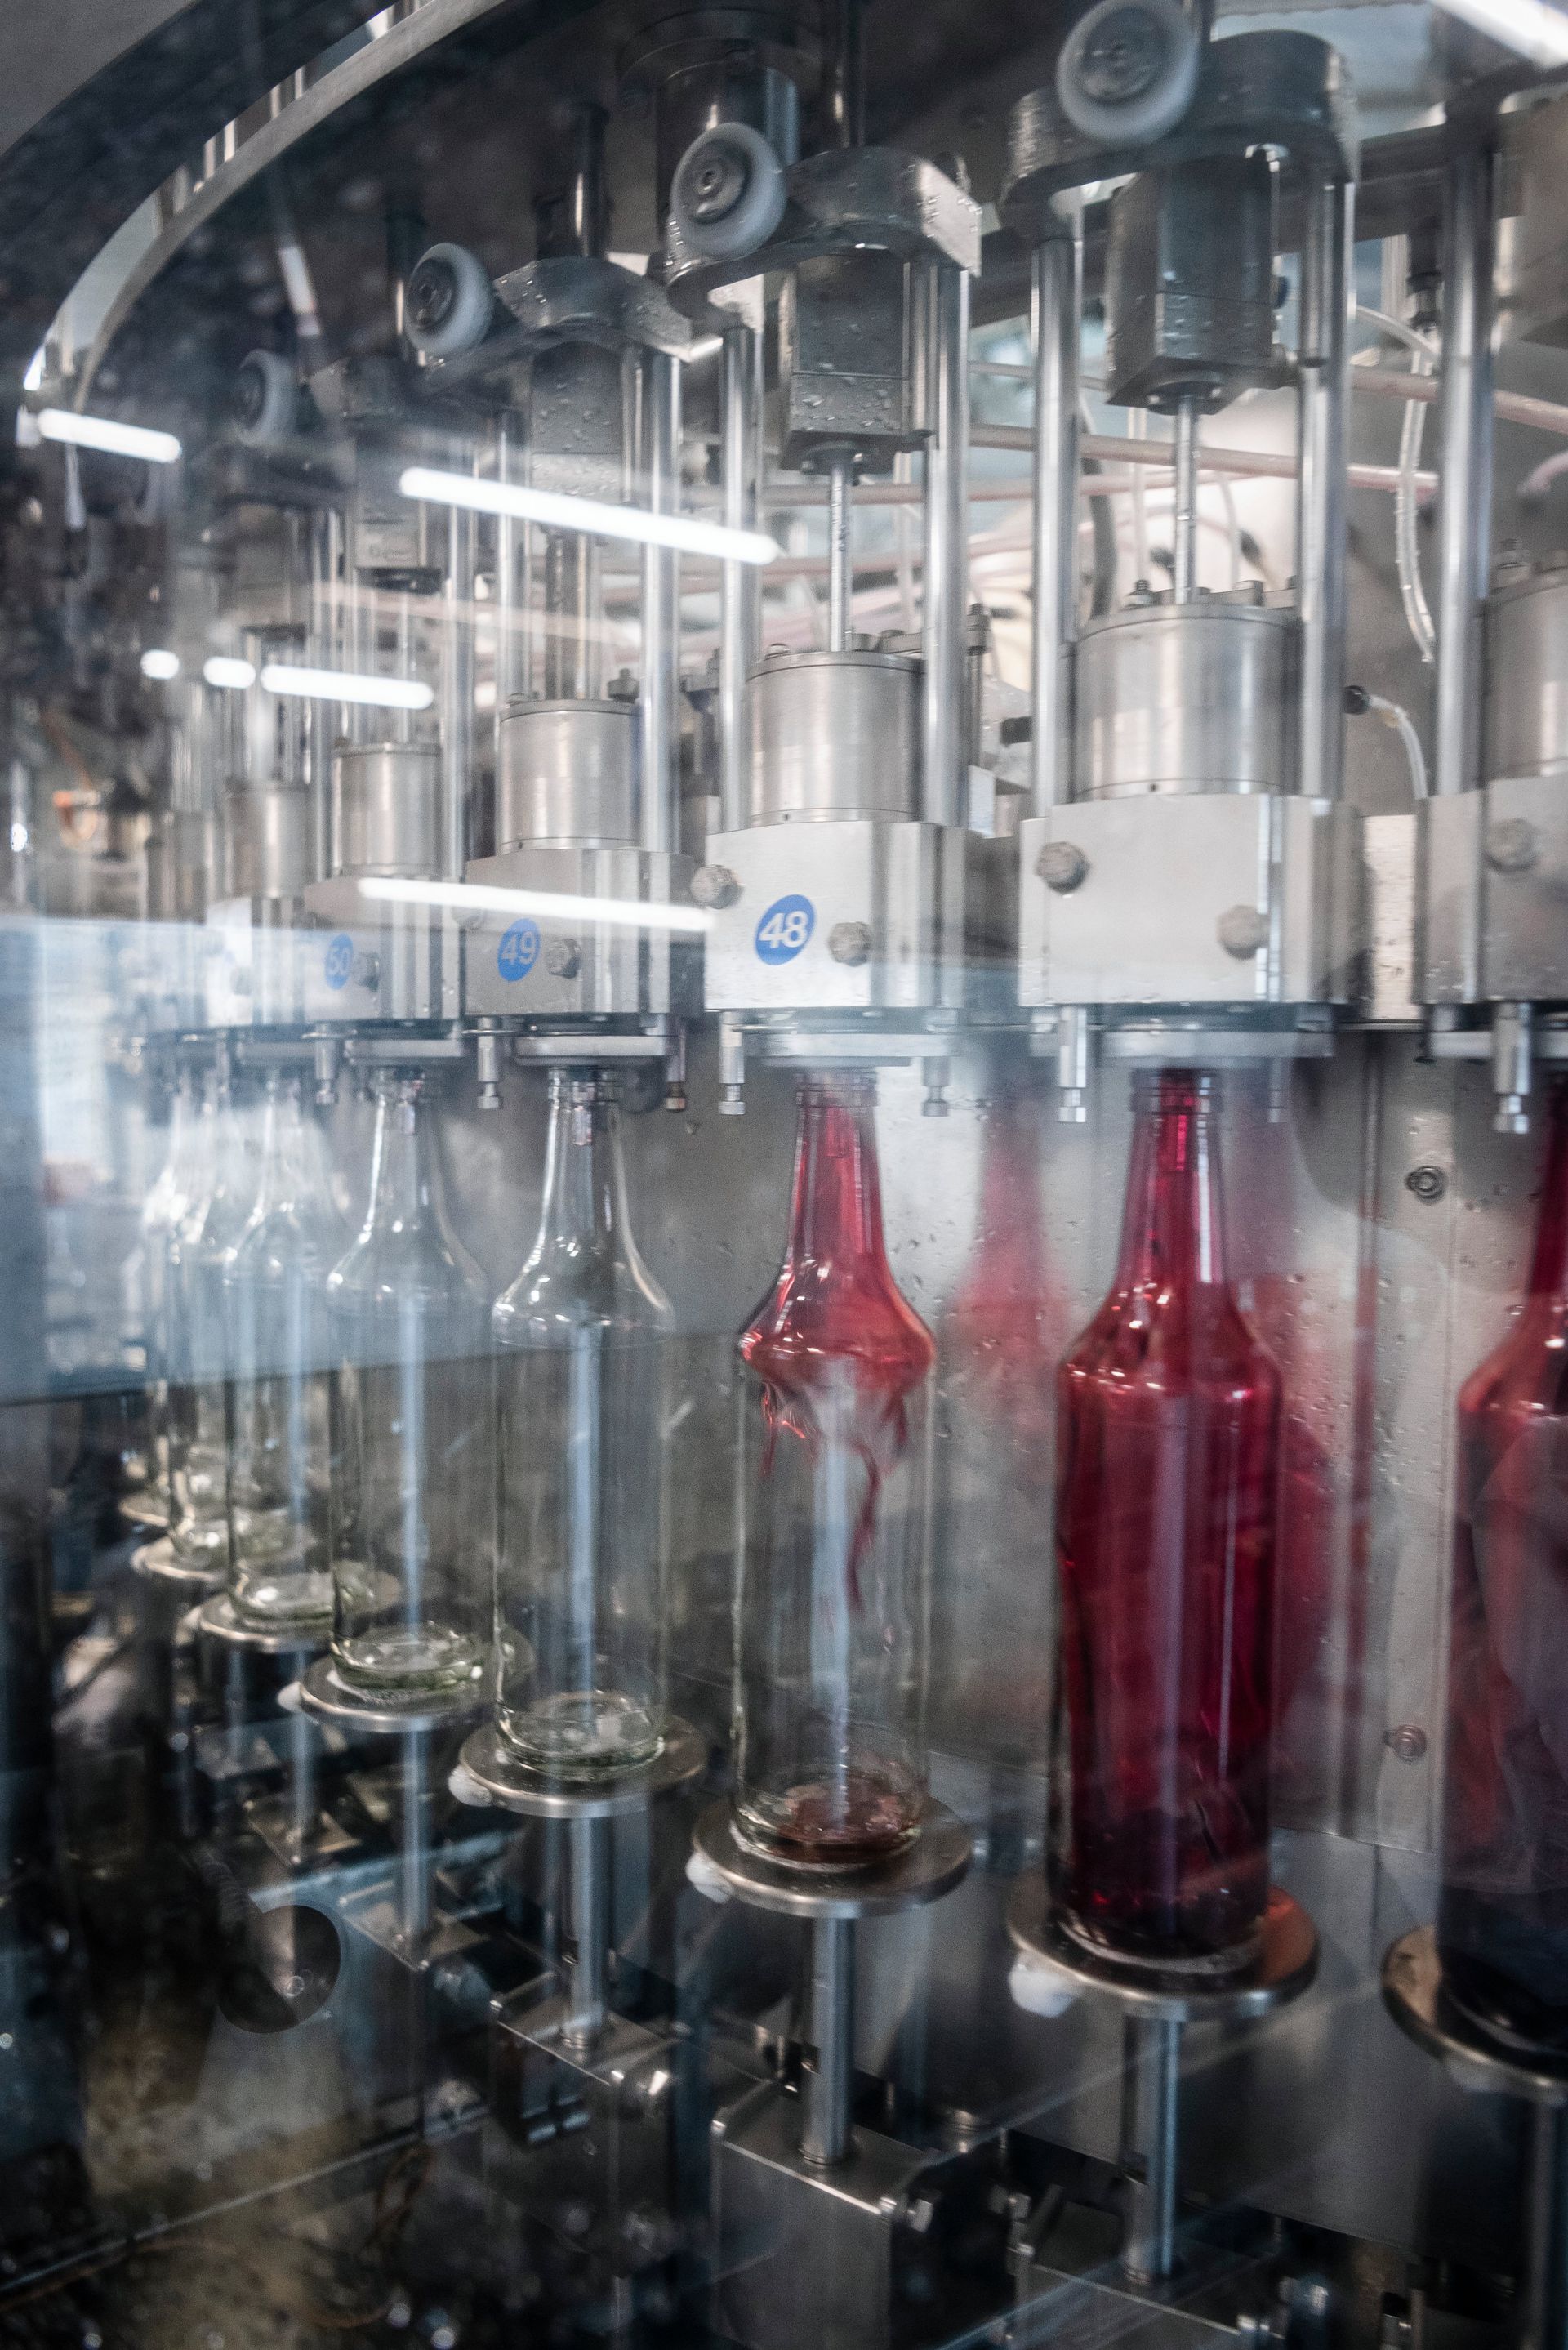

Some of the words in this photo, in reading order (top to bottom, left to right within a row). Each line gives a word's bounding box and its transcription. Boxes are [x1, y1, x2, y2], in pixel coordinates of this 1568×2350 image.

[759, 911, 808, 948] 48
[327, 948, 351, 975] 50
[501, 932, 537, 965] 49
